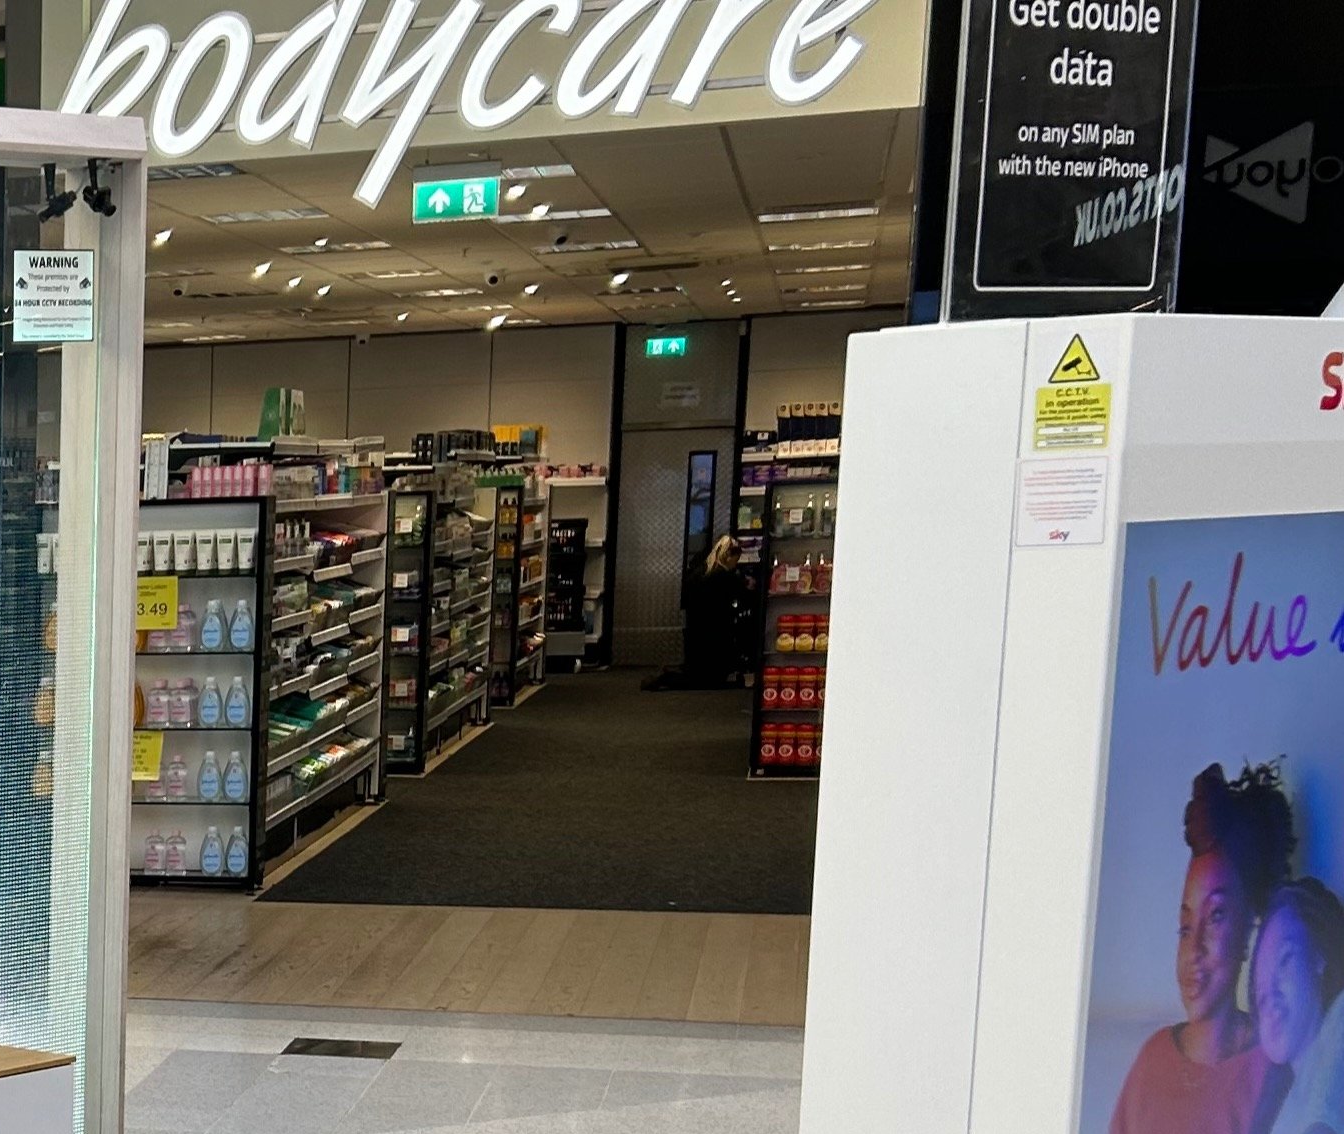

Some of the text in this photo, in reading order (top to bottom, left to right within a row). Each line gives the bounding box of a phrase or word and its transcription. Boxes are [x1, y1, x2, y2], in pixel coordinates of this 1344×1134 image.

[1009, 0, 1161, 34] Get double
[1050, 48, 1114, 88] data
[61, 0, 868, 209] bodycare
[1018, 123, 1135, 152] on any SIM plan
[998, 154, 1149, 180] with the new iPhone
[29, 256, 79, 269] WARNING
[42, 299, 56, 307] CCTV
[1049, 529, 1070, 543] sky
[1149, 551, 1317, 676] Value
